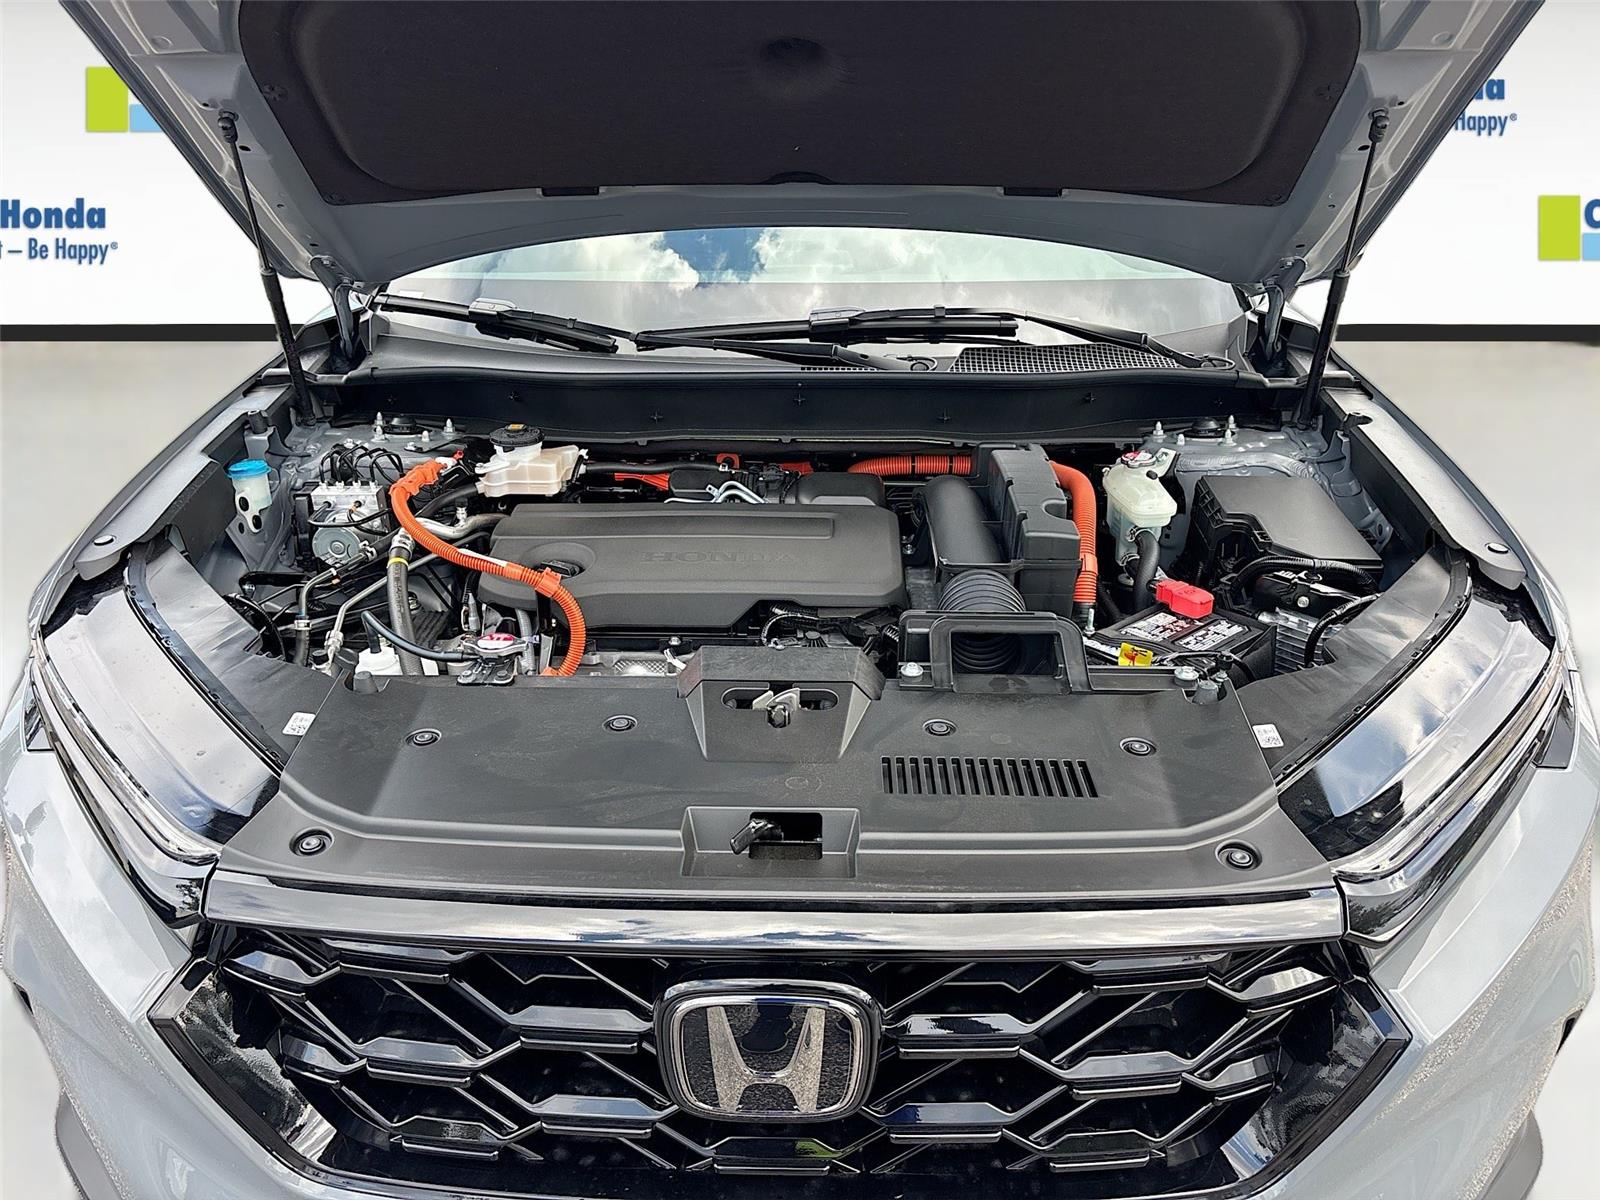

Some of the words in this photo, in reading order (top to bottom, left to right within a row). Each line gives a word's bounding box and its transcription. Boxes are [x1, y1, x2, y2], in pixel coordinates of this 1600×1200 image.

[0, 197, 106, 229] Honda
[28, 237, 49, 260] Be
[640, 550, 795, 564] HONDA
